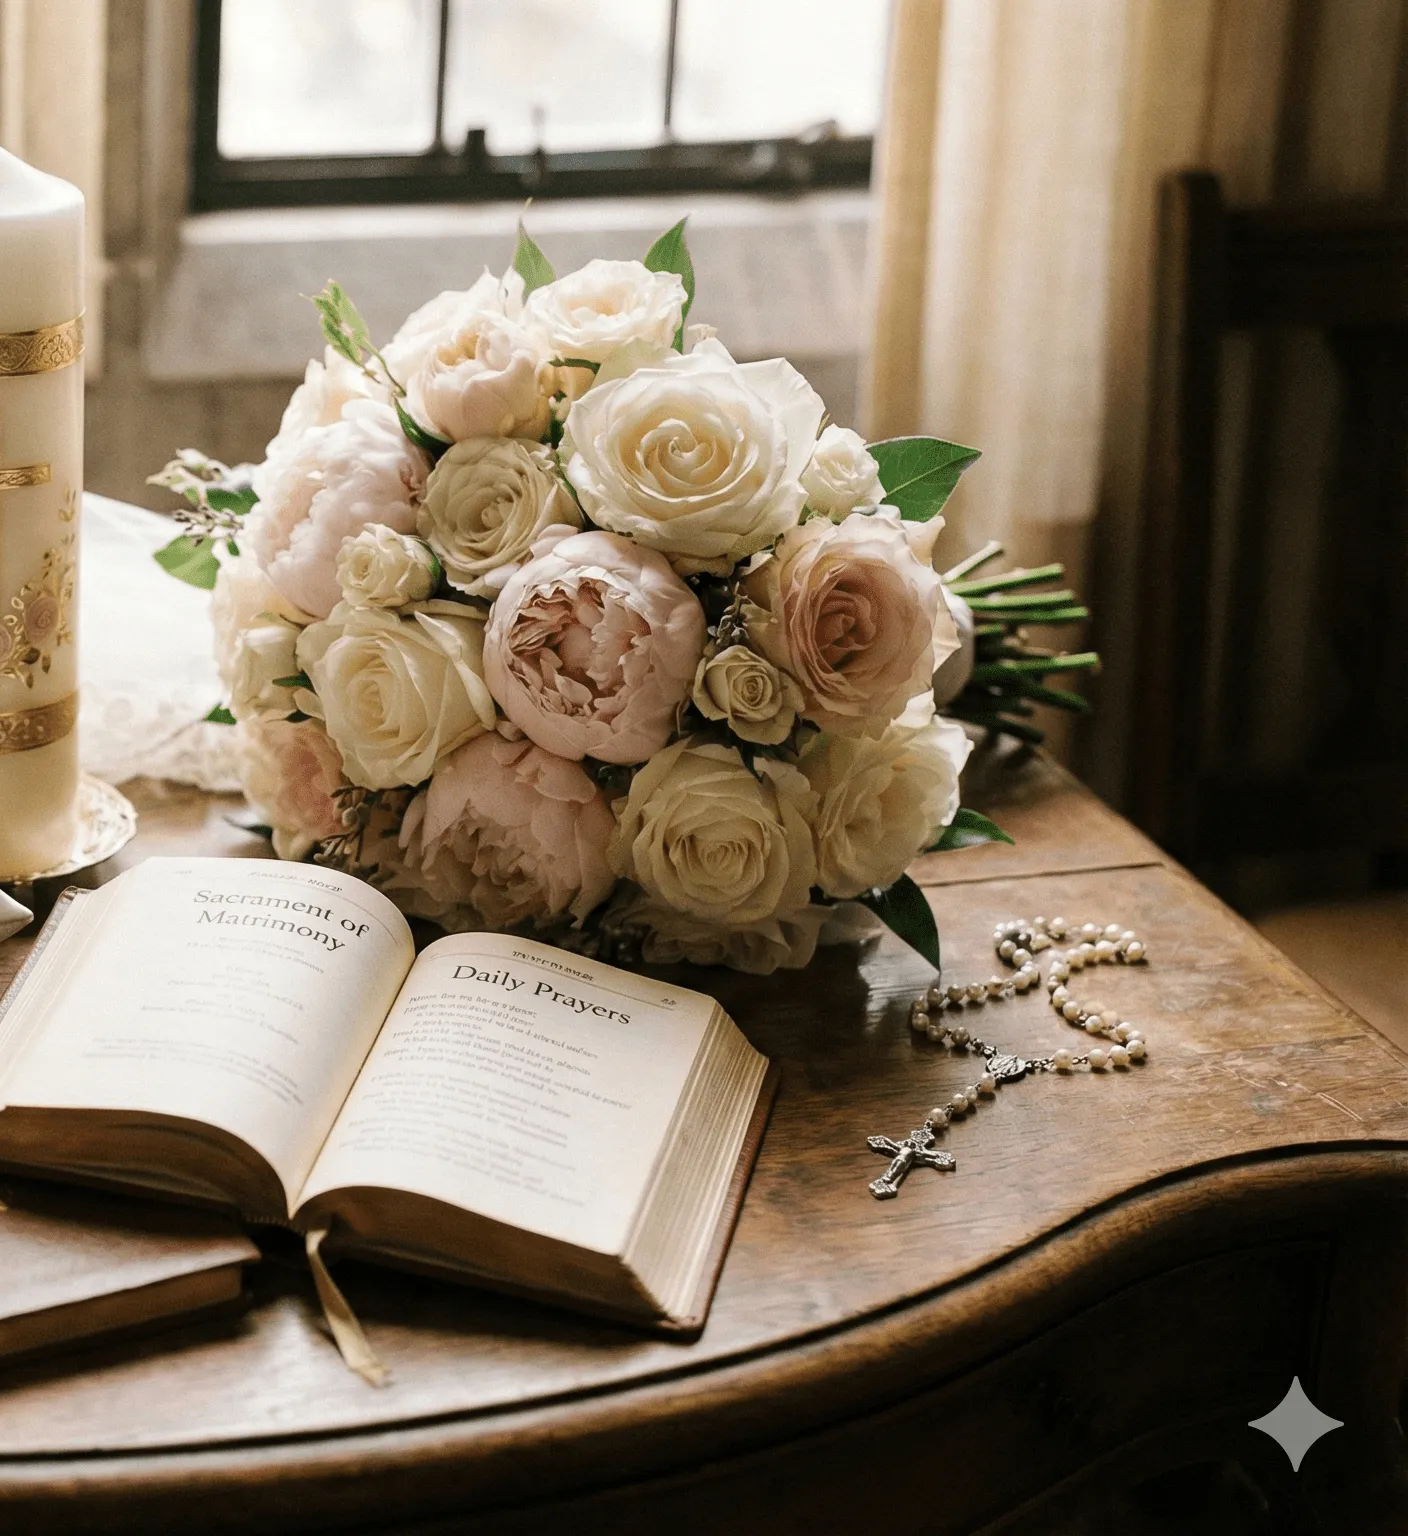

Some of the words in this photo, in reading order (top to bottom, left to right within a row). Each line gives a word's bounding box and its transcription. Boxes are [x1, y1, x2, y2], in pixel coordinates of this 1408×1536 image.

[193, 889, 334, 921] Sacrament
[340, 918, 370, 939] of
[196, 910, 346, 951] Matrimony
[452, 965, 526, 992] Daily
[533, 981, 631, 1025] Prayers
